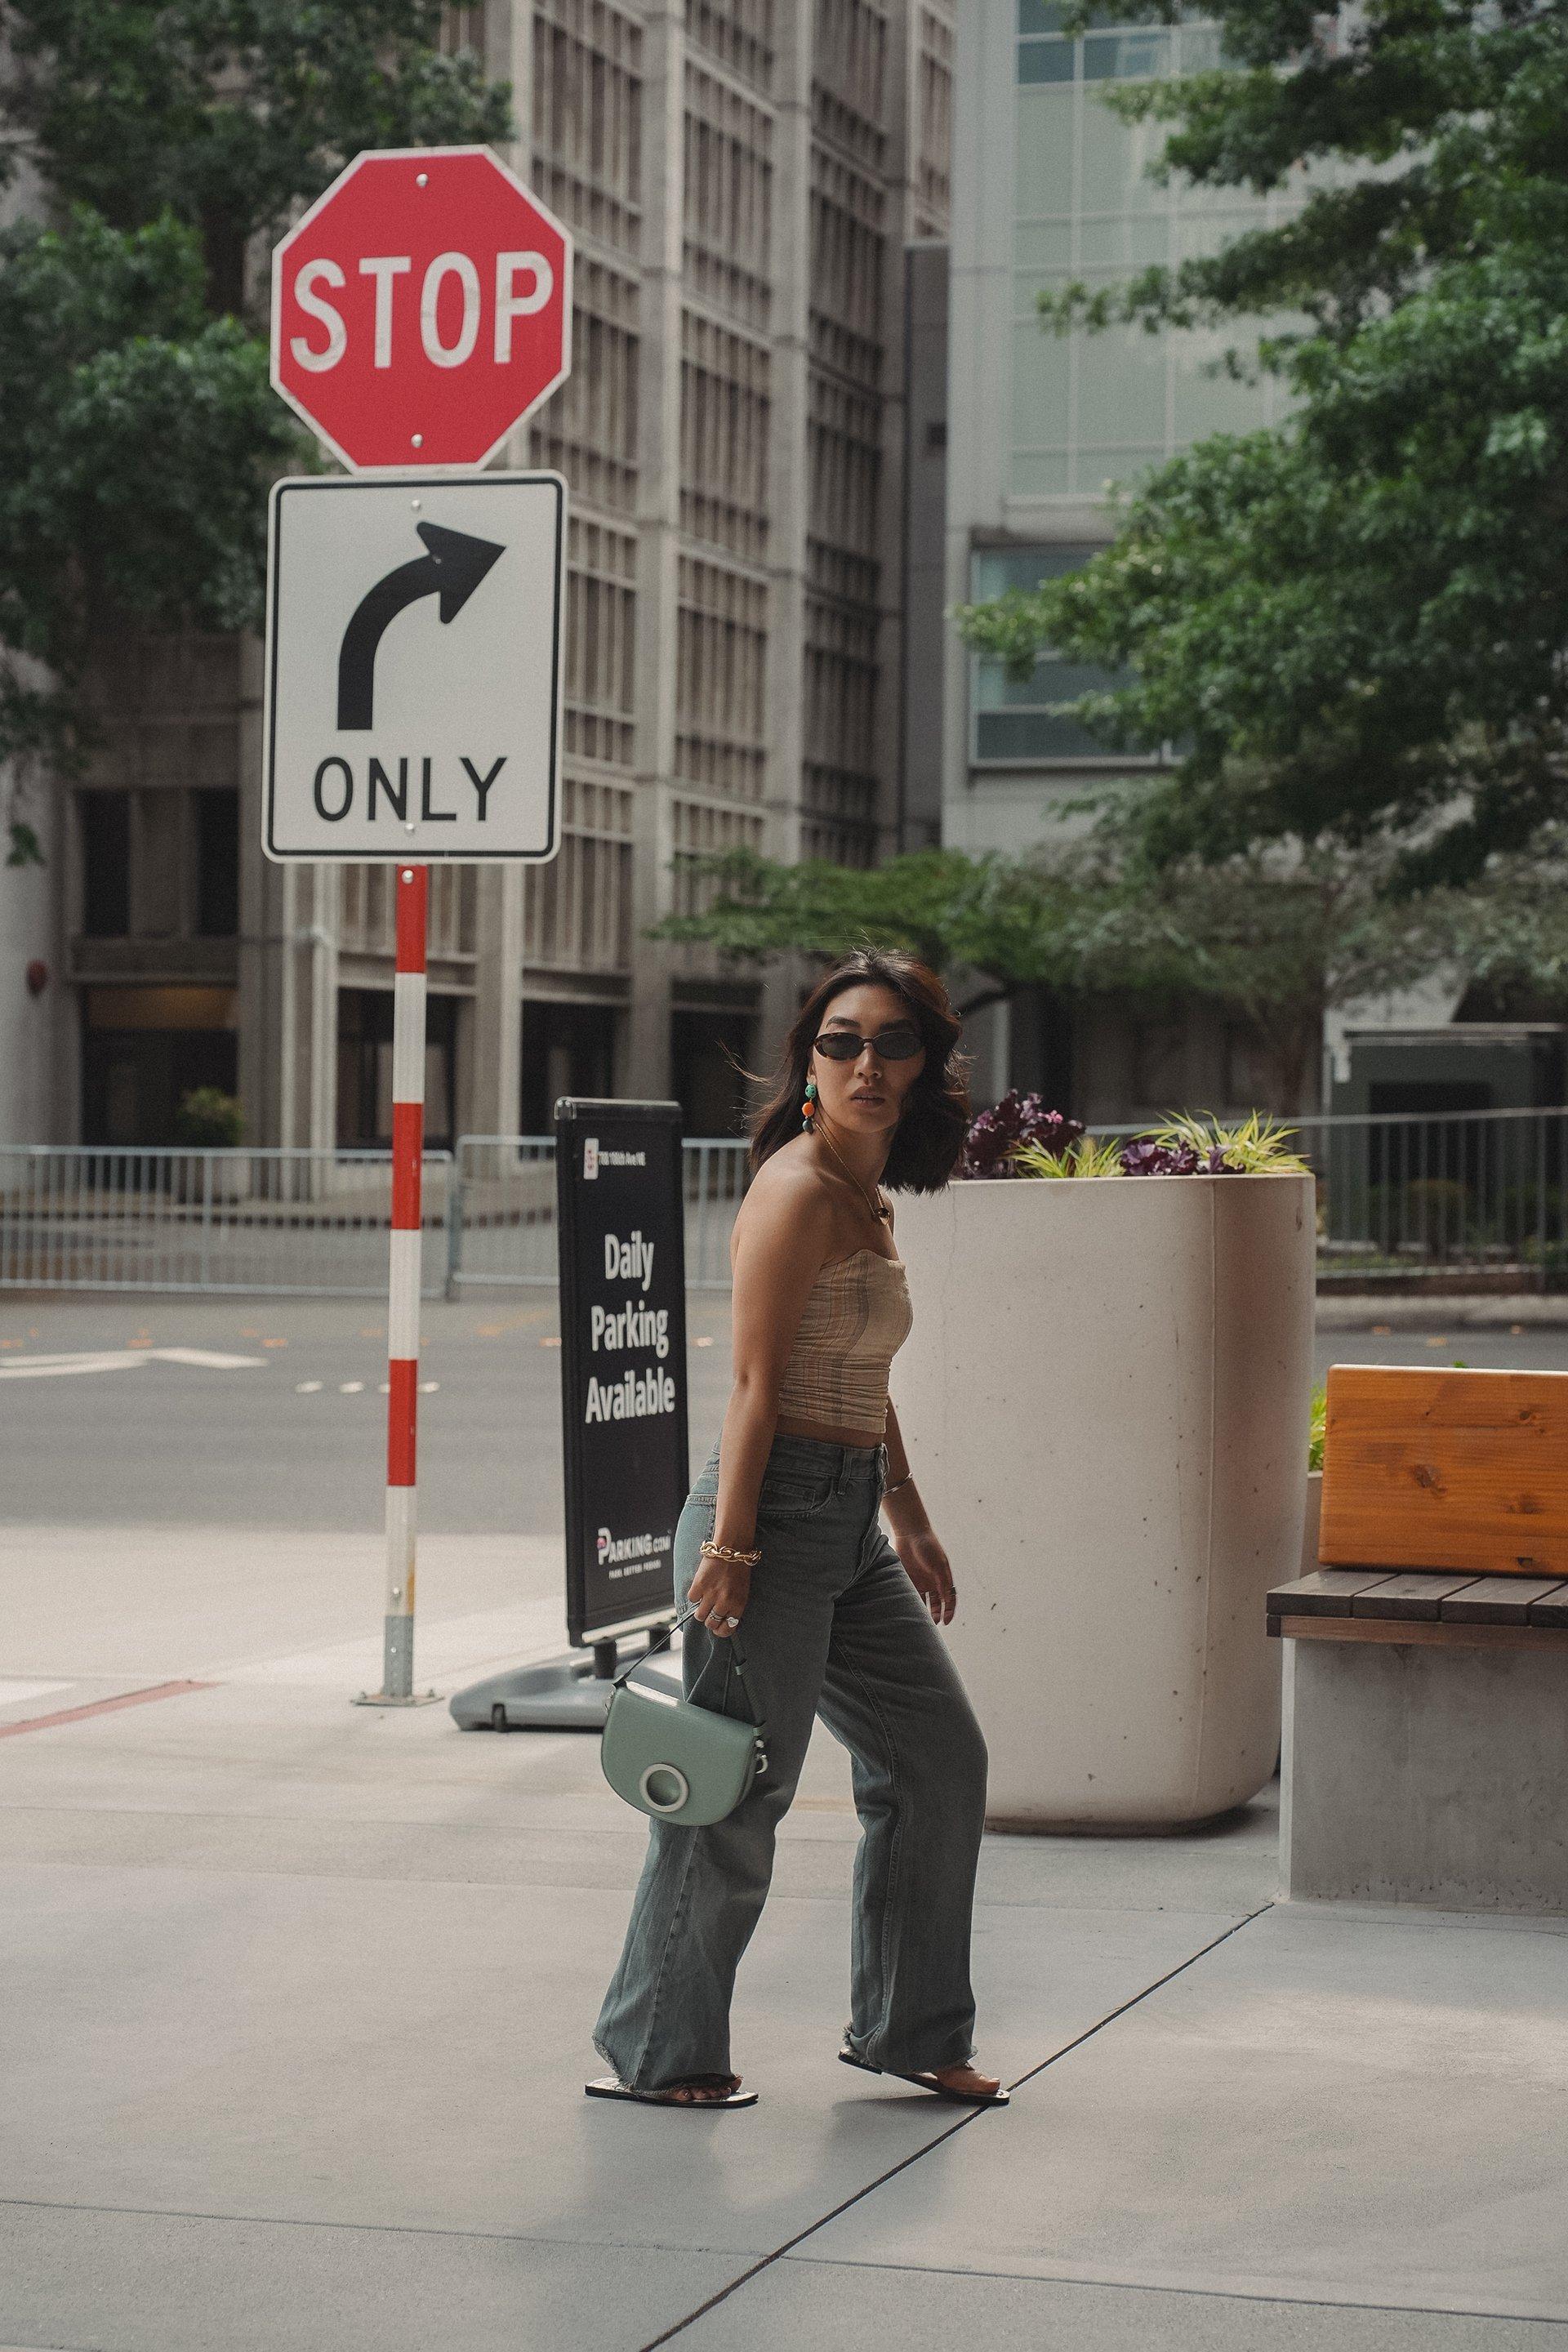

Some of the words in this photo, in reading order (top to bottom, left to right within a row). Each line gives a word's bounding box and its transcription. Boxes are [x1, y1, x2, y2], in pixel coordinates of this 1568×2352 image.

[290, 251, 555, 373] STOP
[314, 756, 508, 822] ONLY
[604, 1230, 654, 1292] Daily
[590, 1299, 670, 1359] Parking
[585, 1365, 675, 1423] Available
